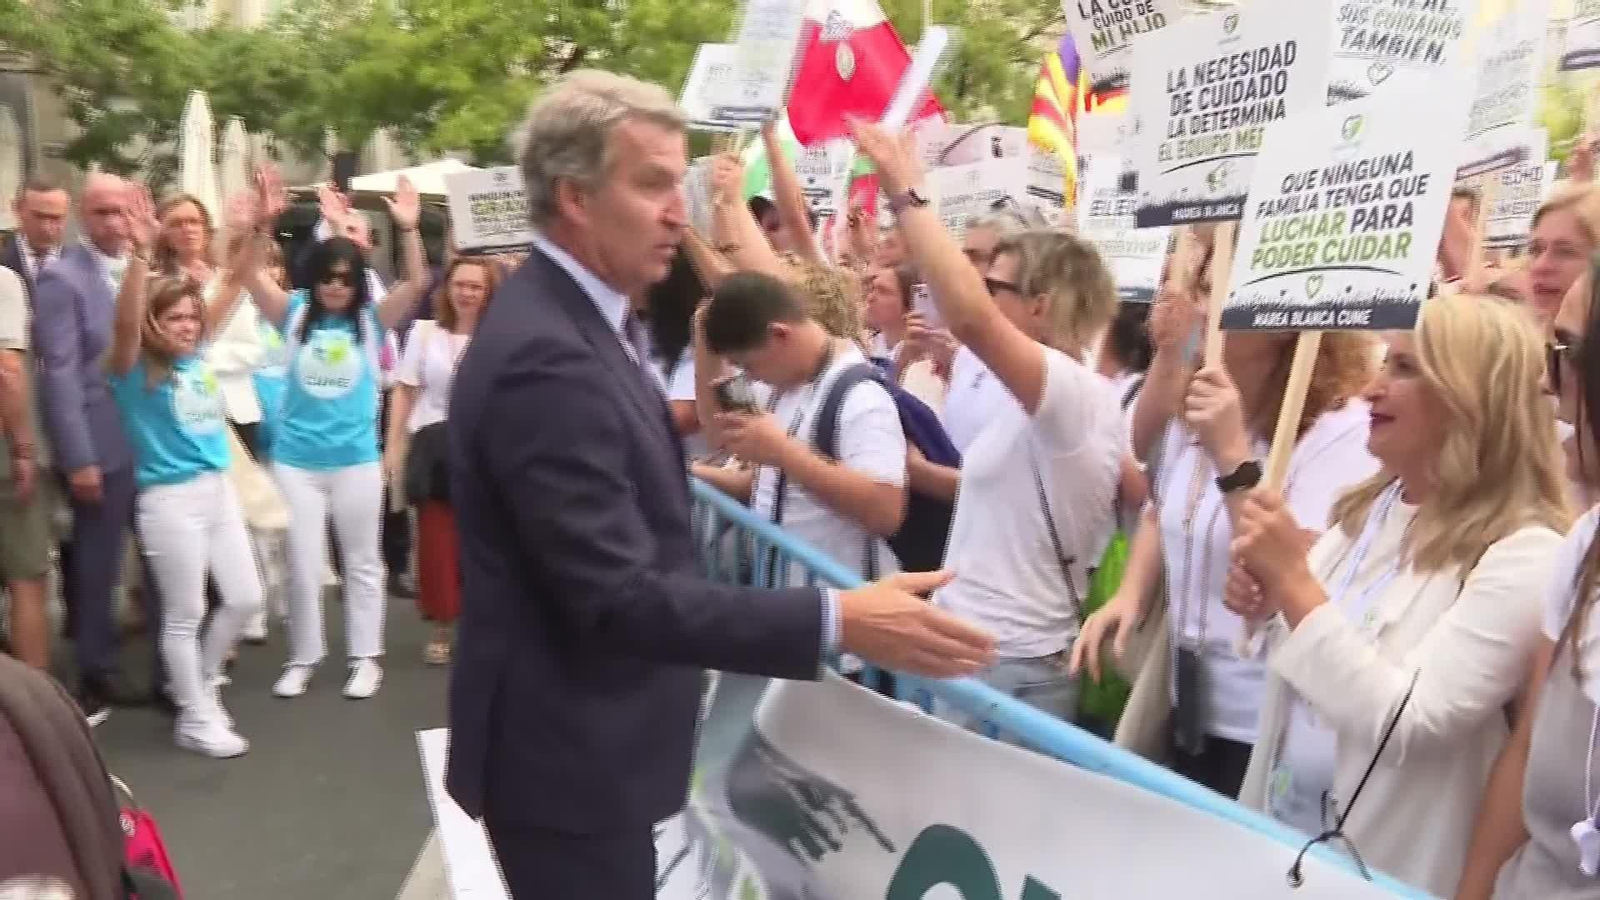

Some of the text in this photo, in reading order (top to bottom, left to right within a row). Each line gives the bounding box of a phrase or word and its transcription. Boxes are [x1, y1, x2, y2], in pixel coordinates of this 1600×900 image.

[1078, 0, 1104, 20] LA
[1093, 8, 1133, 30] CUIDO
[1136, 2, 1155, 16] DE
[1337, 4, 1462, 40] SUS CUIDADOS
[1090, 12, 1167, 52] MI HIJO
[1167, 40, 1298, 93] LA NECESIDAD
[1169, 70, 1288, 116] DE CUIDADO
[1167, 99, 1286, 139] LA DETERMINA
[1158, 143, 1173, 162] EL
[1177, 133, 1231, 160] EQUIPO
[1280, 150, 1413, 194] QUE NINGUNA
[1255, 173, 1431, 219] FAMILIA TENGA QUE
[1259, 201, 1414, 244] LUCHAR PARA
[1250, 232, 1412, 269] PODER CUIDAR
[1252, 308, 1373, 327] MAREA BLANCA CUME
